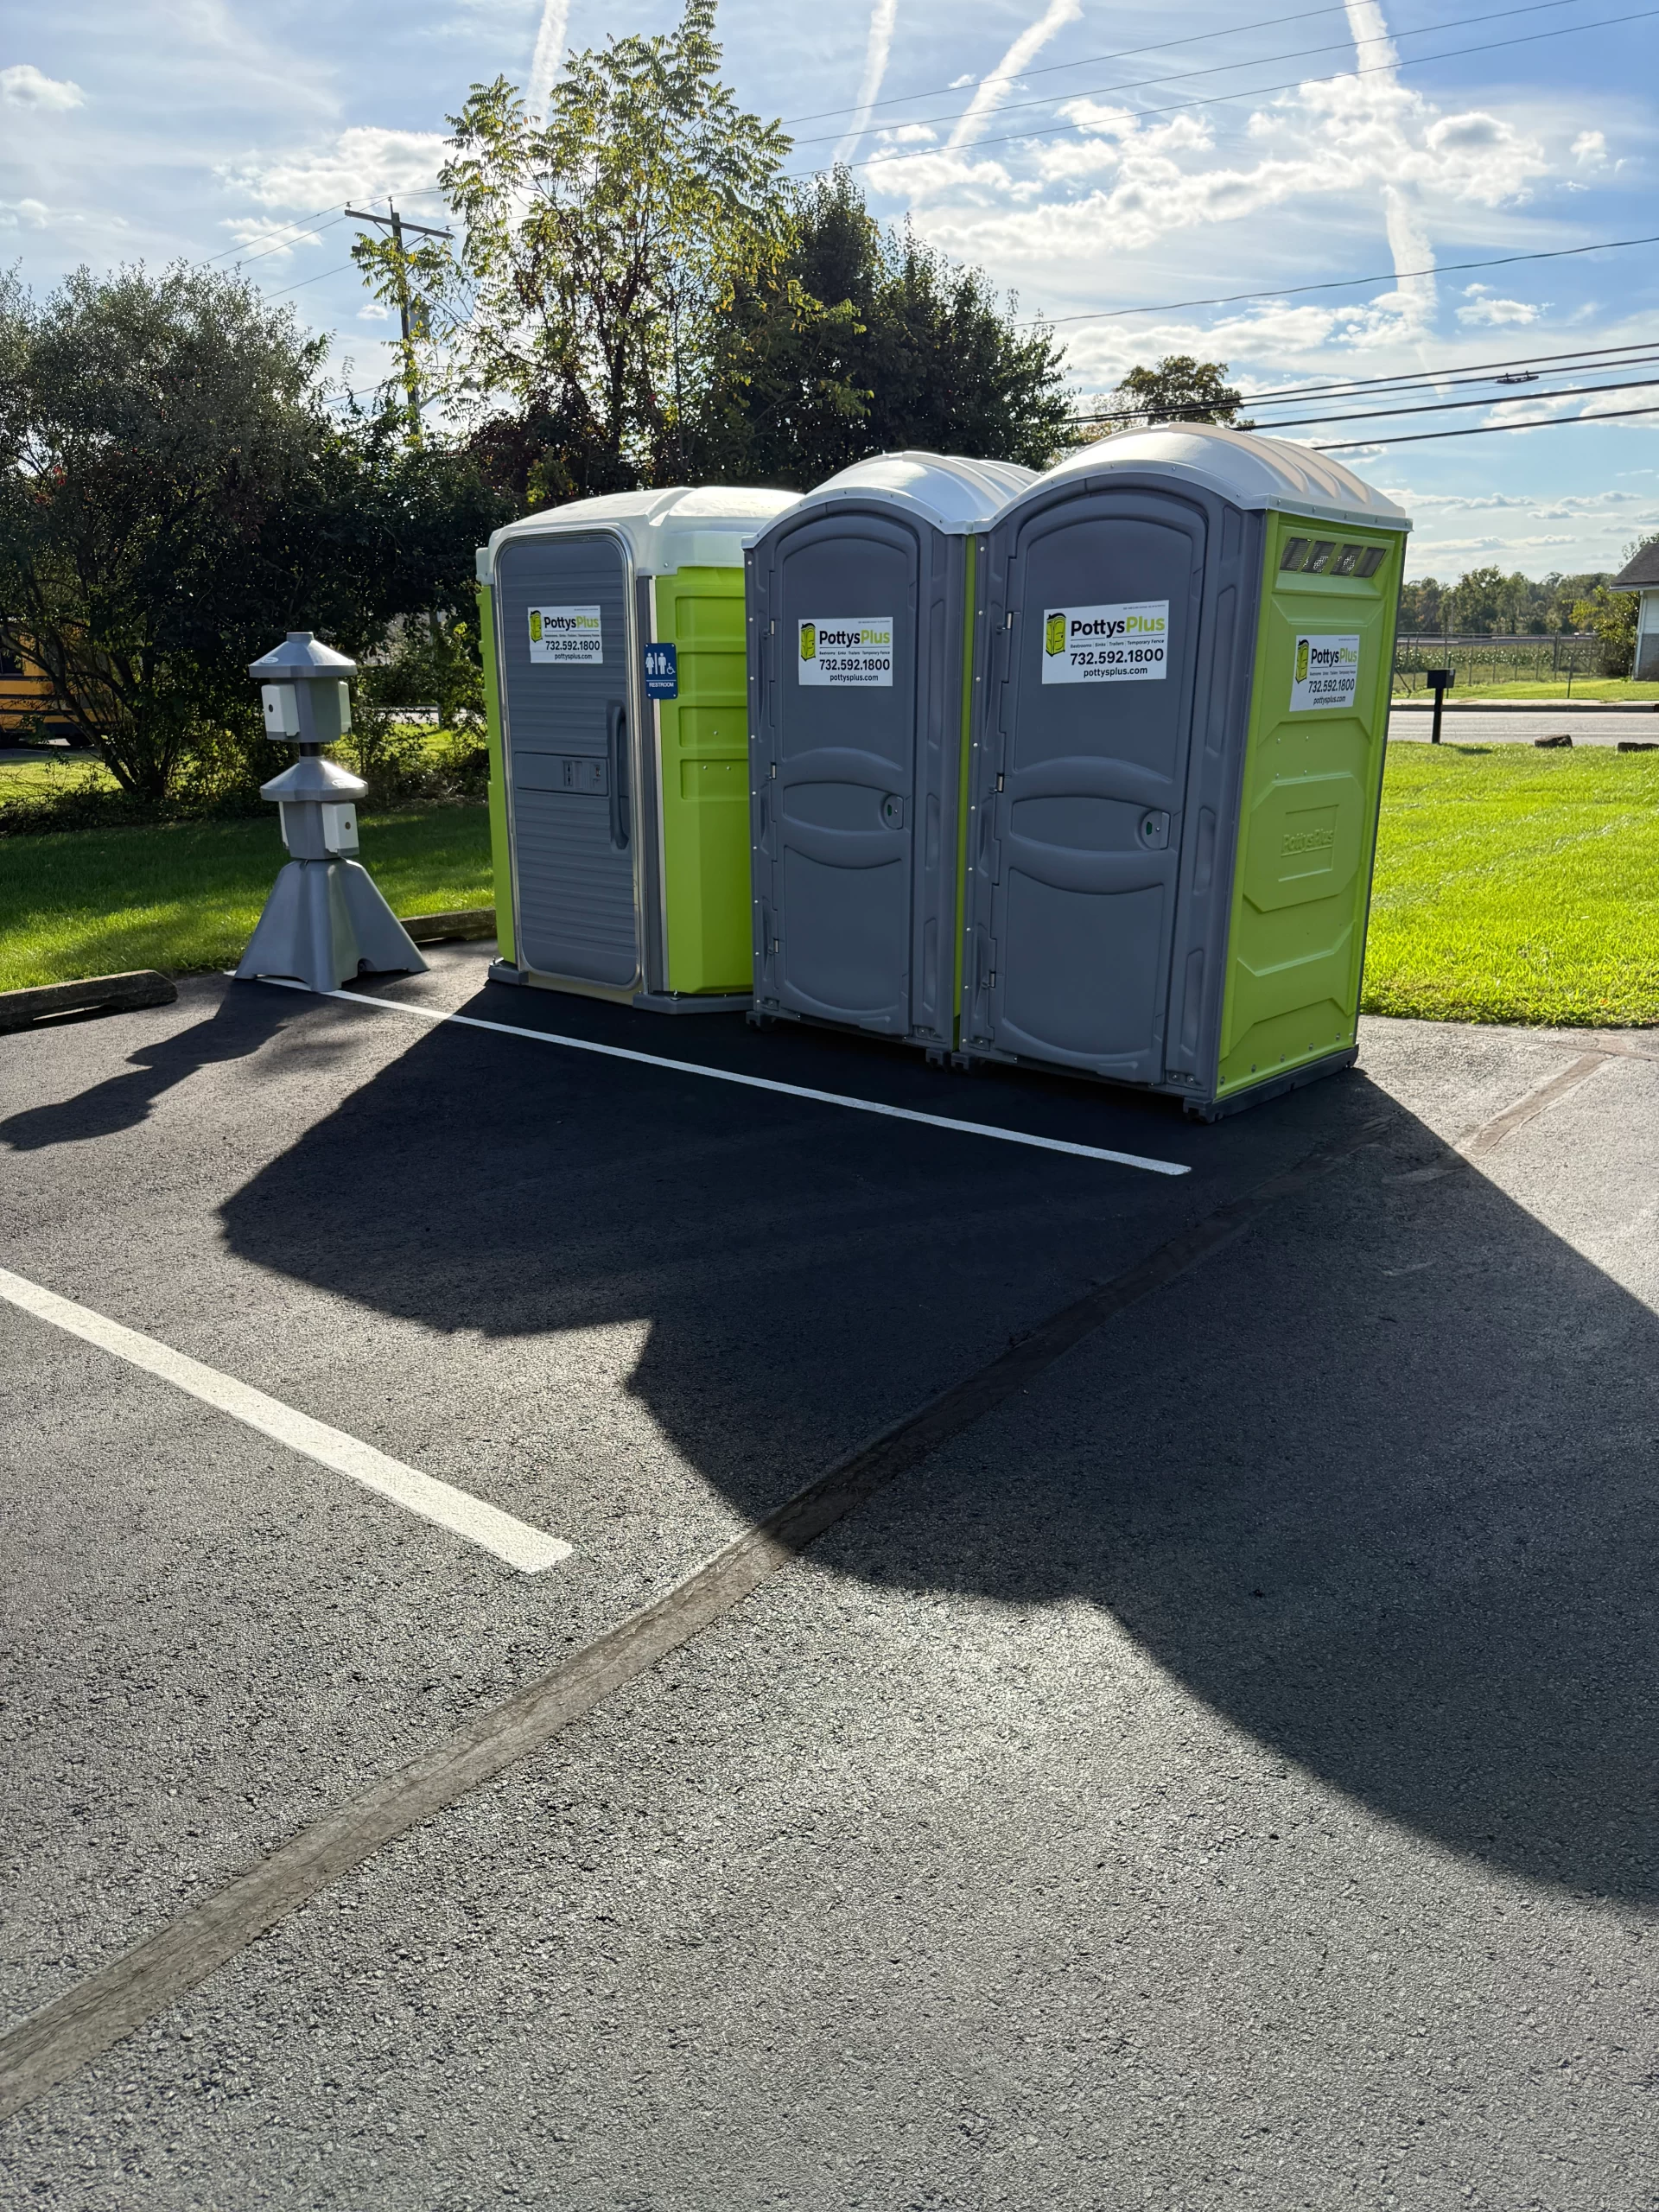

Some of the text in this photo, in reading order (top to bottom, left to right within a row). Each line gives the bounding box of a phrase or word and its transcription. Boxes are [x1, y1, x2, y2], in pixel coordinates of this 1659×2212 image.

[543, 615, 600, 631] PottysPlus
[1071, 615, 1165, 638] PottysPlus
[545, 640, 601, 651] 732.592.1800
[819, 630, 890, 648] PottysPlus
[1070, 648, 1164, 665] 732.592.1800
[1310, 647, 1357, 667] PottysPlus
[820, 658, 890, 671] 732.592.1800
[1084, 667, 1147, 678] pottysplus.com
[1308, 678, 1355, 693] 732.592.1800
[1313, 696, 1346, 706] pottysplus.com
